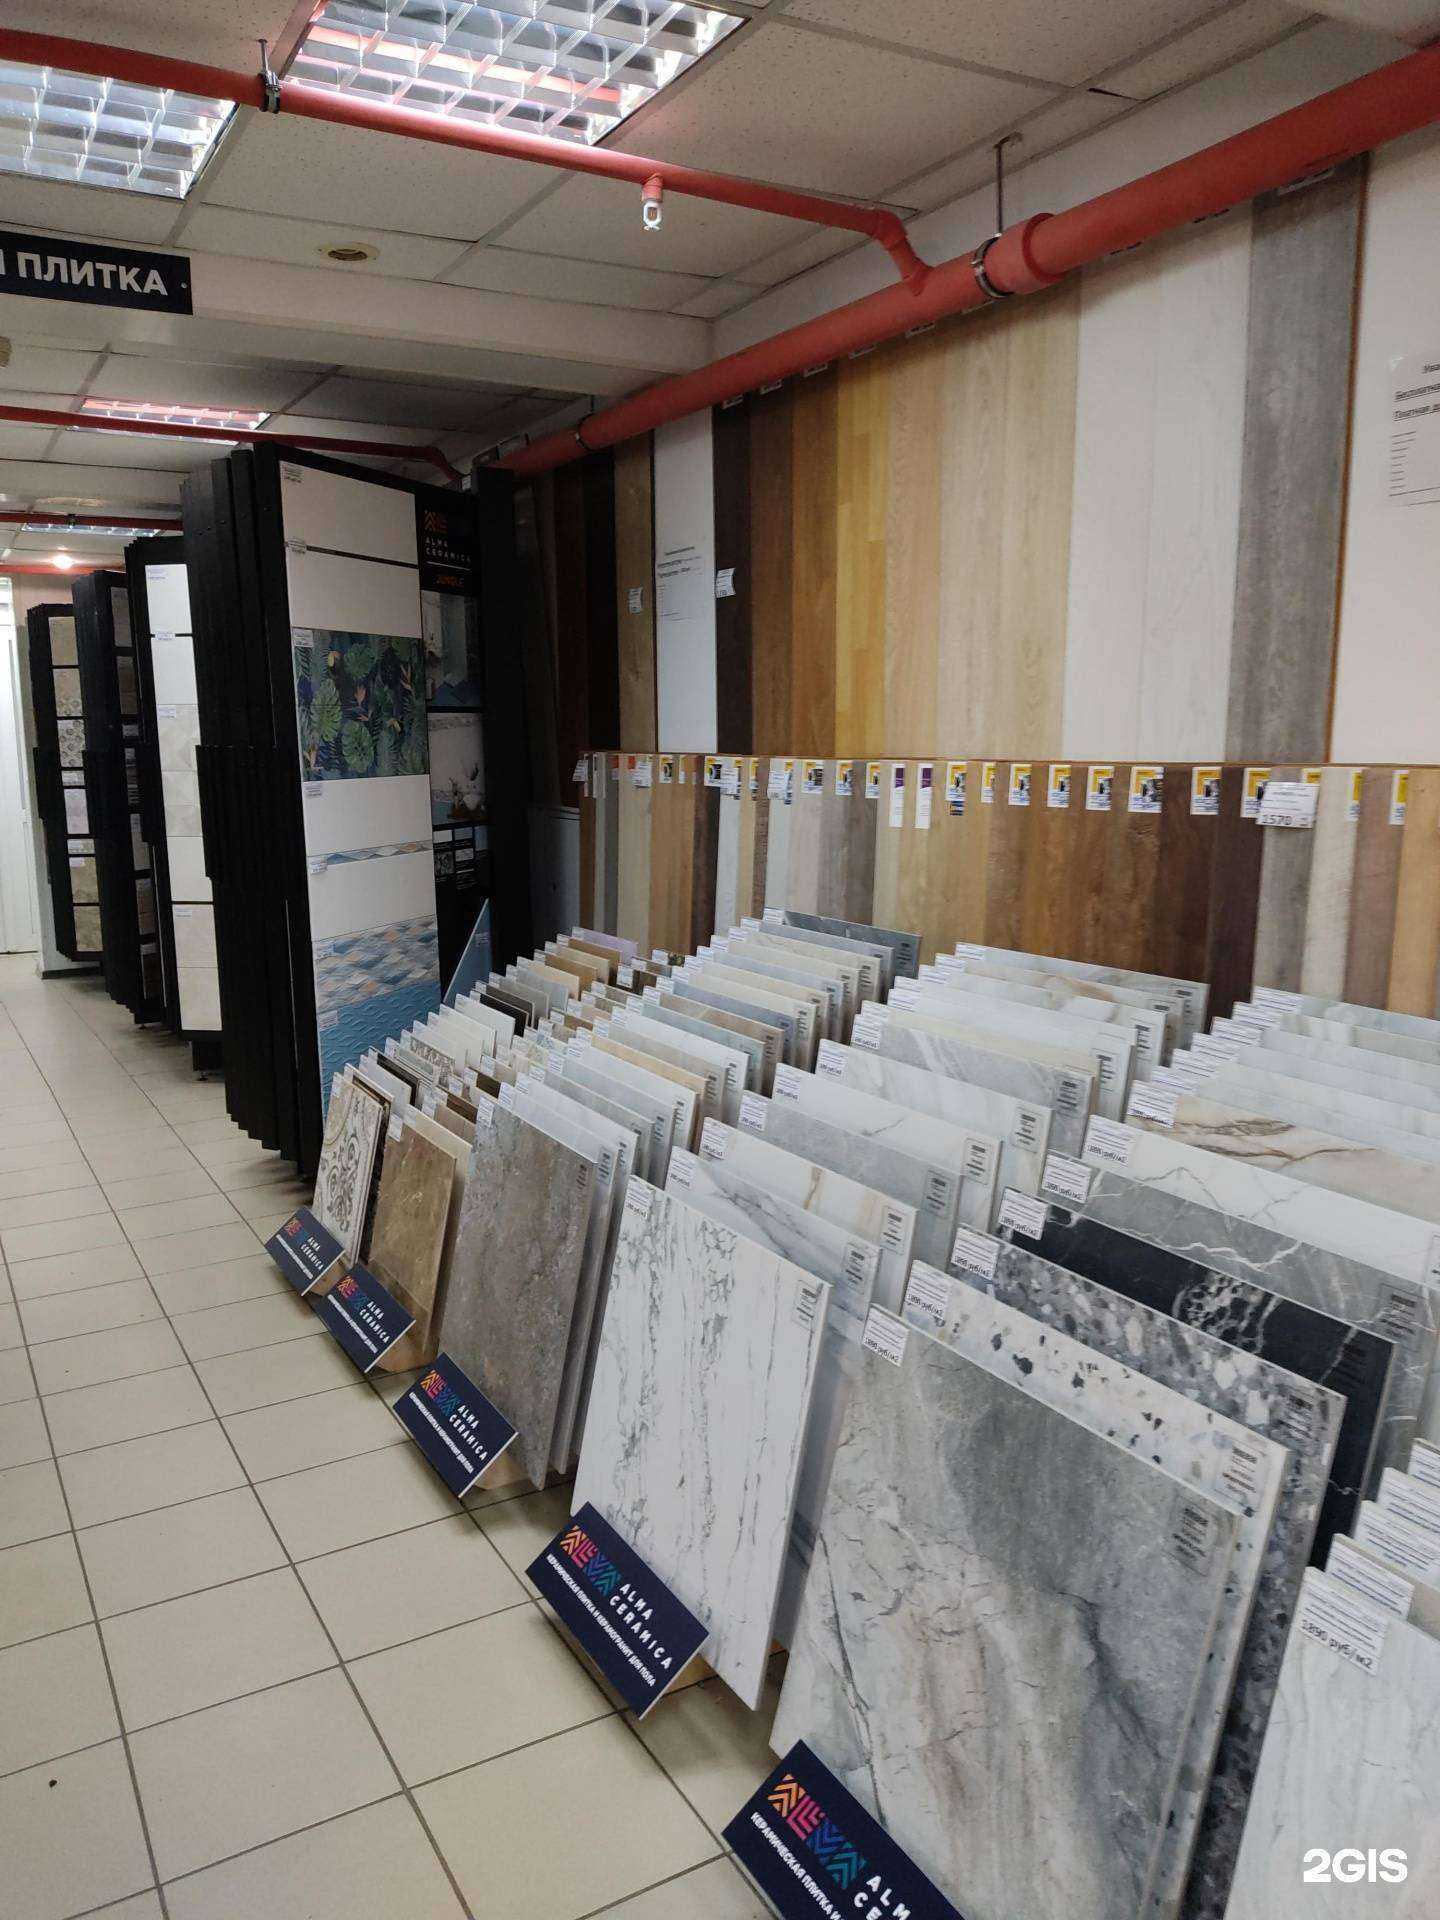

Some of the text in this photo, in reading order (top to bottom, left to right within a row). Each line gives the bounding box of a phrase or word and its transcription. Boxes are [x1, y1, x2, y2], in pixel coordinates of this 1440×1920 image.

[16, 251, 168, 296] ПЛИТКА
[360, 1308, 389, 1343] CERAMICA
[367, 1301, 384, 1319] ALMA
[448, 1413, 488, 1460] CERAMICA
[457, 1404, 479, 1429] ALMA
[546, 1553, 579, 1593] КЕРАМИЧЕСКАЯ
[576, 1590, 595, 1613] ПЛИТКА
[596, 1614, 632, 1658] КЕРАМОГРАНИТ
[629, 1654, 642, 1671] ДЛЯ
[638, 1666, 655, 1687] ПОЛА
[619, 1583, 653, 1619] ALMA
[609, 1595, 673, 1668] CERAMICA
[750, 1811, 806, 1880] КЕРАМИЧЕСКАЯ
[801, 1872, 834, 1916] ПЛИТКА
